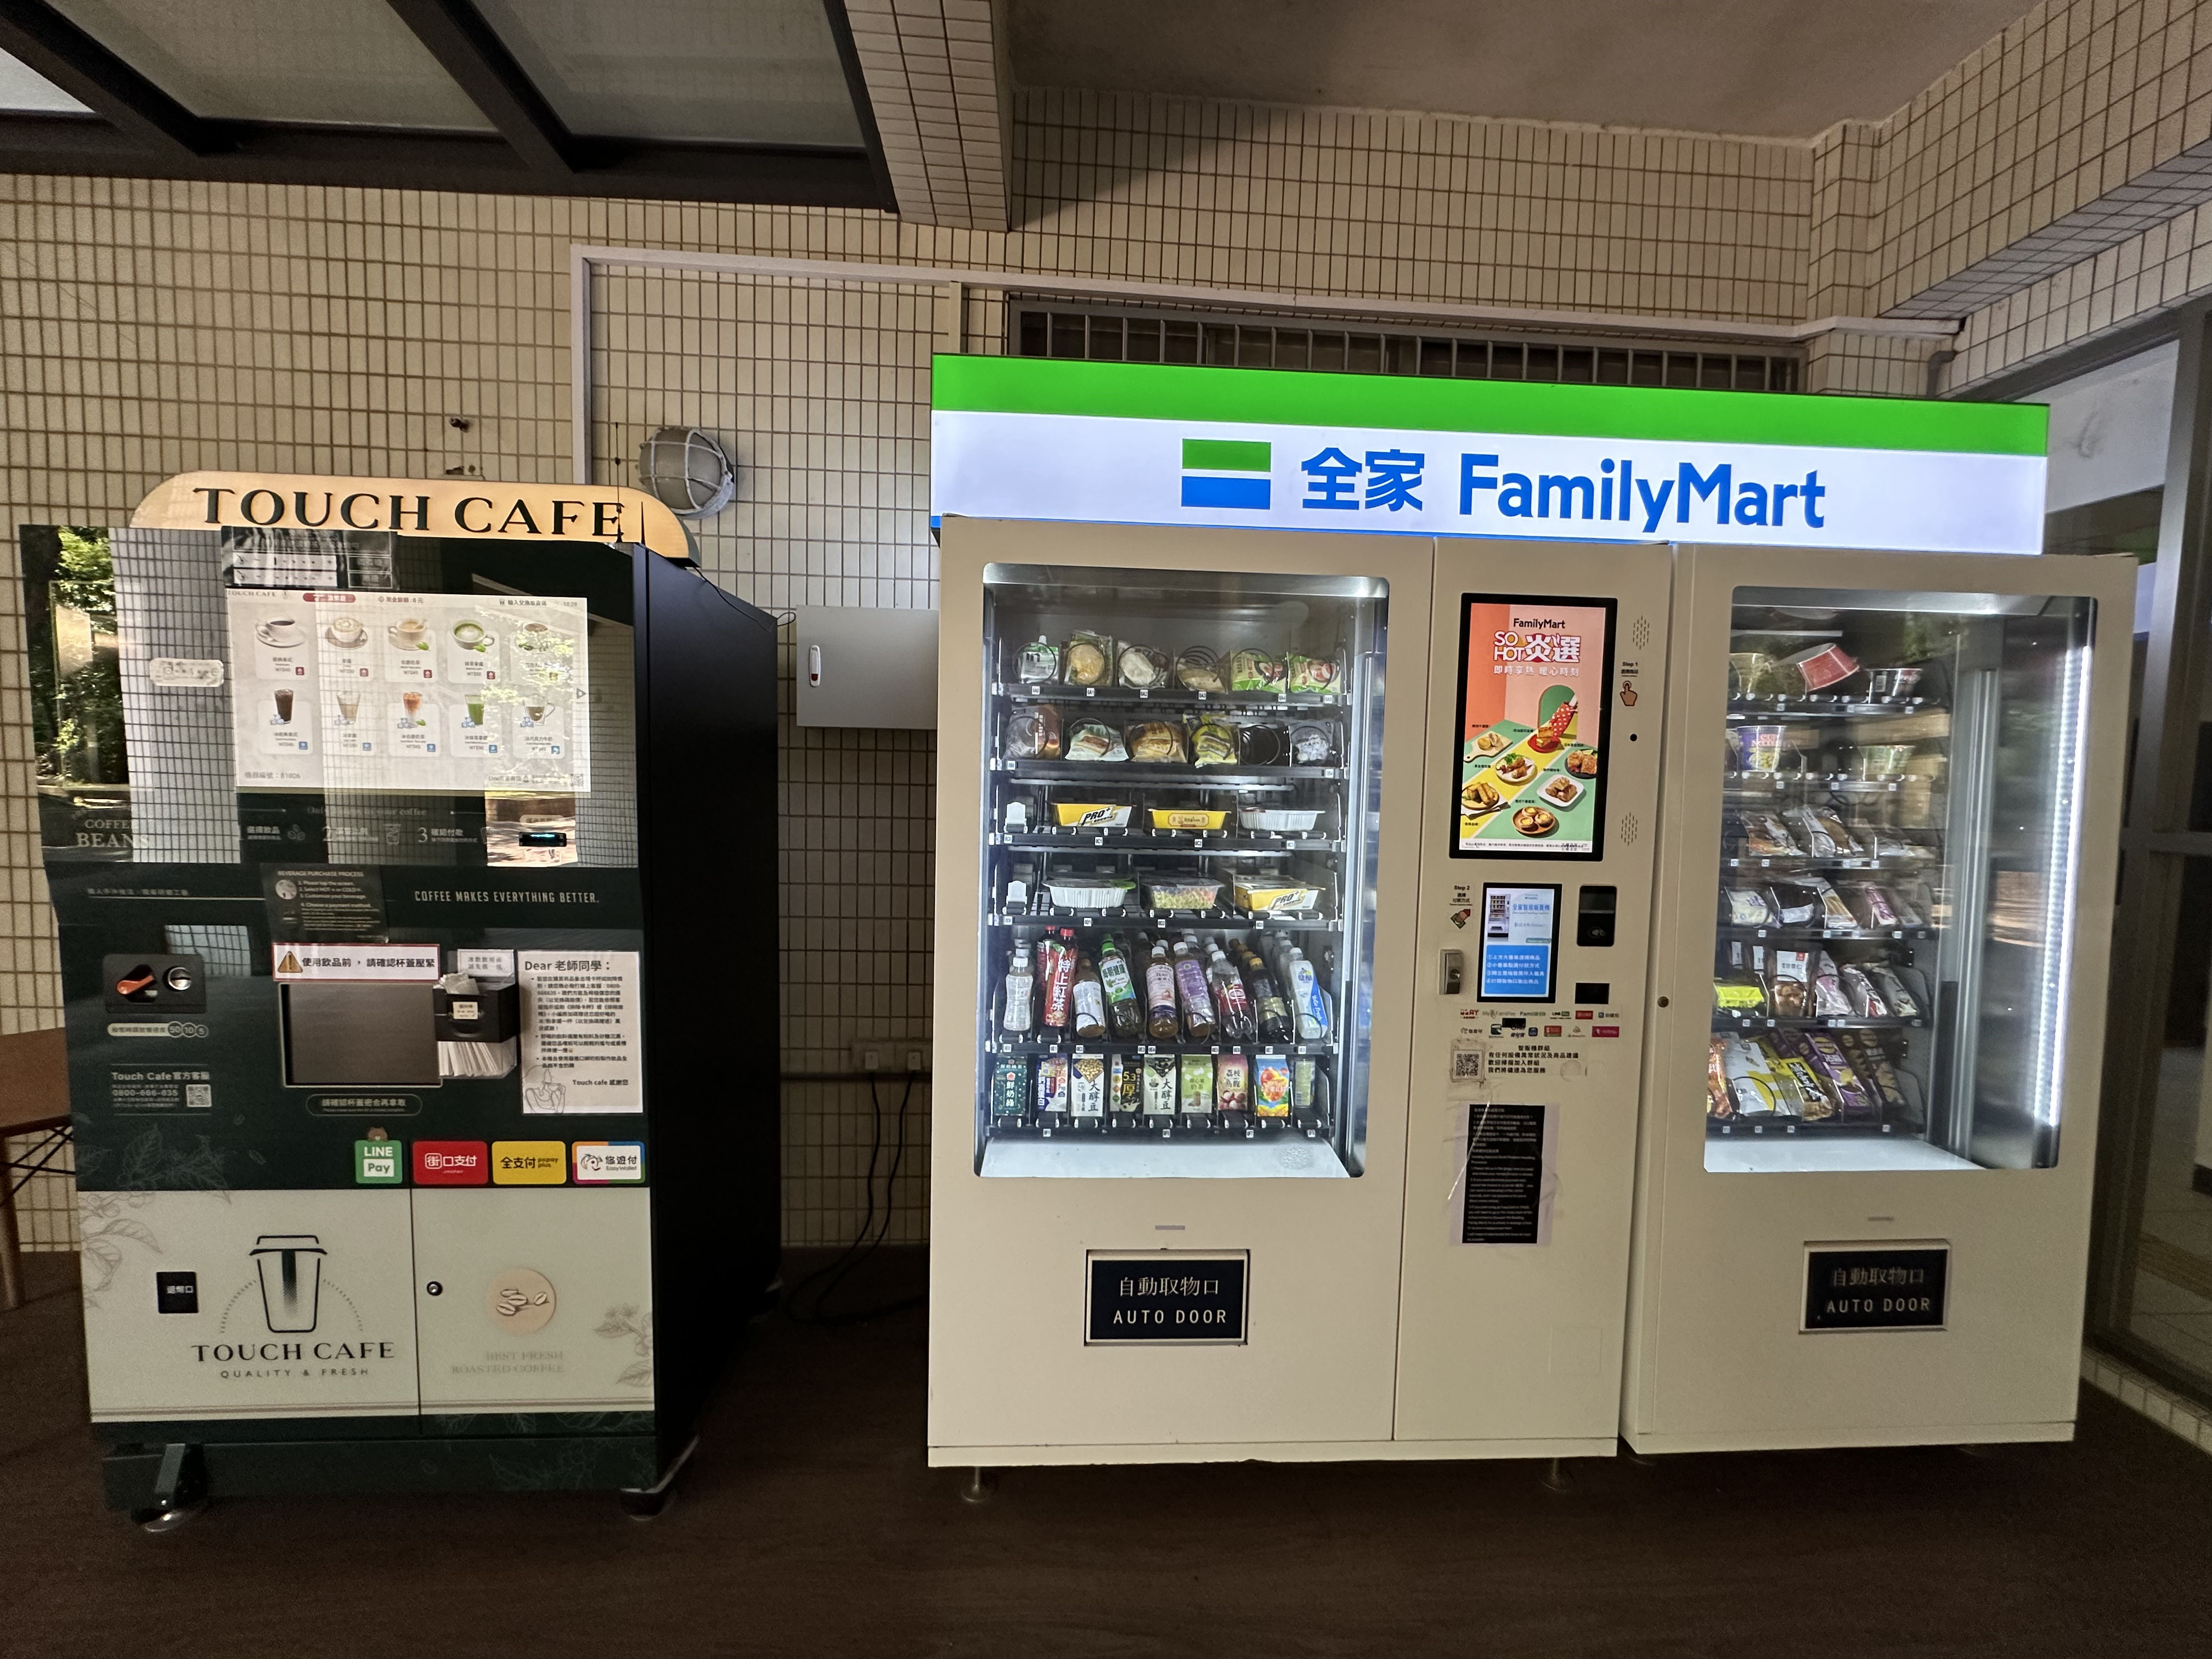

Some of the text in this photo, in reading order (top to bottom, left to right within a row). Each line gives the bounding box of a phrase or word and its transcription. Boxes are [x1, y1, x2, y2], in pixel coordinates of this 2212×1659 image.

[1301, 447, 1826, 533] 全家 FamilyMart
[193, 487, 625, 536] TOUCH CAFE
[1514, 618, 1565, 629] FamilyMart
[1494, 631, 1519, 646] SO
[1494, 646, 1525, 661] HOT
[1539, 666, 1579, 676] 暖心時刻
[418, 827, 427, 843] 3
[414, 890, 600, 904] COFFEE MAKES EVERYTHING BETTER.
[524, 960, 610, 972] Dear 老師同學：
[111, 1071, 144, 1080] Touch
[146, 1072, 172, 1080] Cafe
[1226, 1069, 1241, 1077] 荔枝
[1087, 1079, 1101, 1112] 大醇豆
[1160, 1078, 1173, 1110] 大醇豆
[363, 1146, 393, 1157] LINE
[425, 1153, 478, 1169] 街口支付
[500, 1156, 537, 1169] 全支付
[605, 1155, 637, 1165] 悠遊付
[368, 1163, 391, 1173] Pay
[1833, 1266, 1924, 1287] 自動取物口
[1119, 1276, 1219, 1297] 自動取物口
[1826, 1297, 1930, 1314] AUTO DOOR
[1113, 1309, 1227, 1324] AUTO DOOR
[190, 1341, 395, 1362] TOUCH CAFE
[220, 1368, 369, 1379] QUALITY & FRESH
